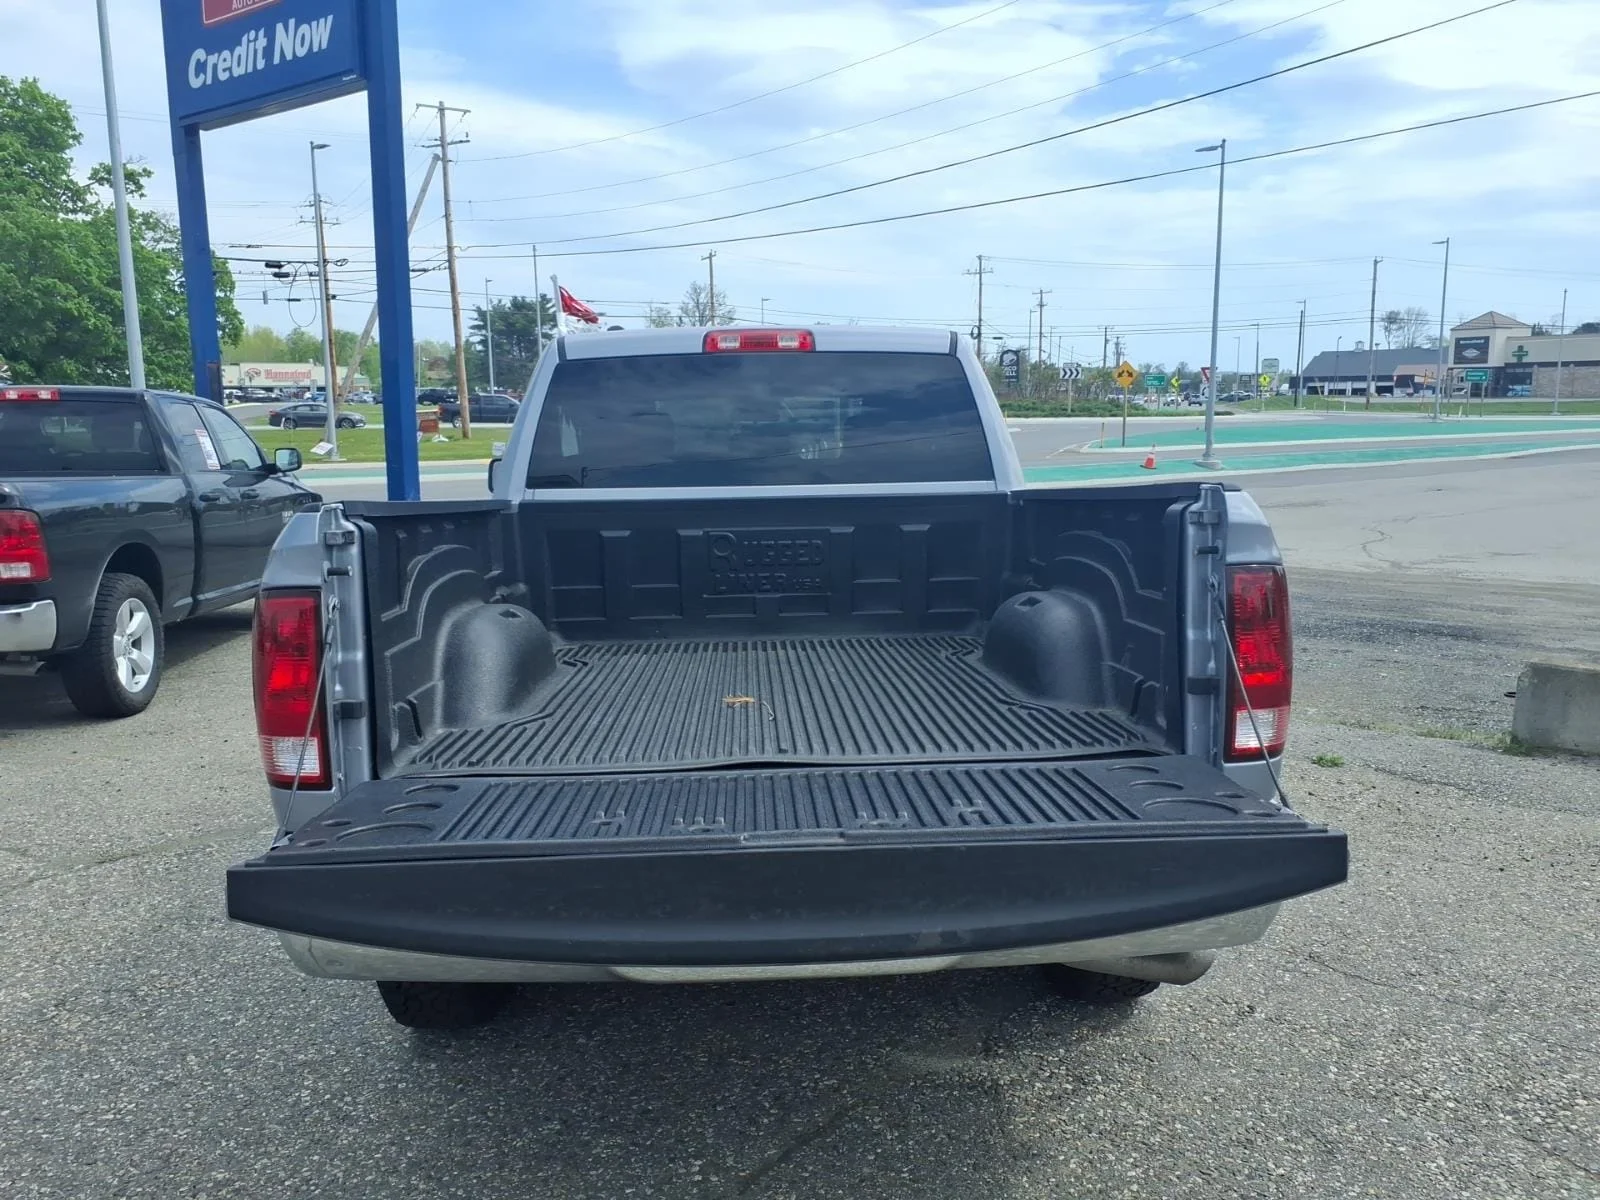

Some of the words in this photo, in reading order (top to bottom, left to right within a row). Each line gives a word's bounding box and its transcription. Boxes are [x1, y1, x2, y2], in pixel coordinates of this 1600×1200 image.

[188, 28, 267, 89] Credit
[273, 14, 334, 65] Now
[709, 531, 825, 572] RUGGED
